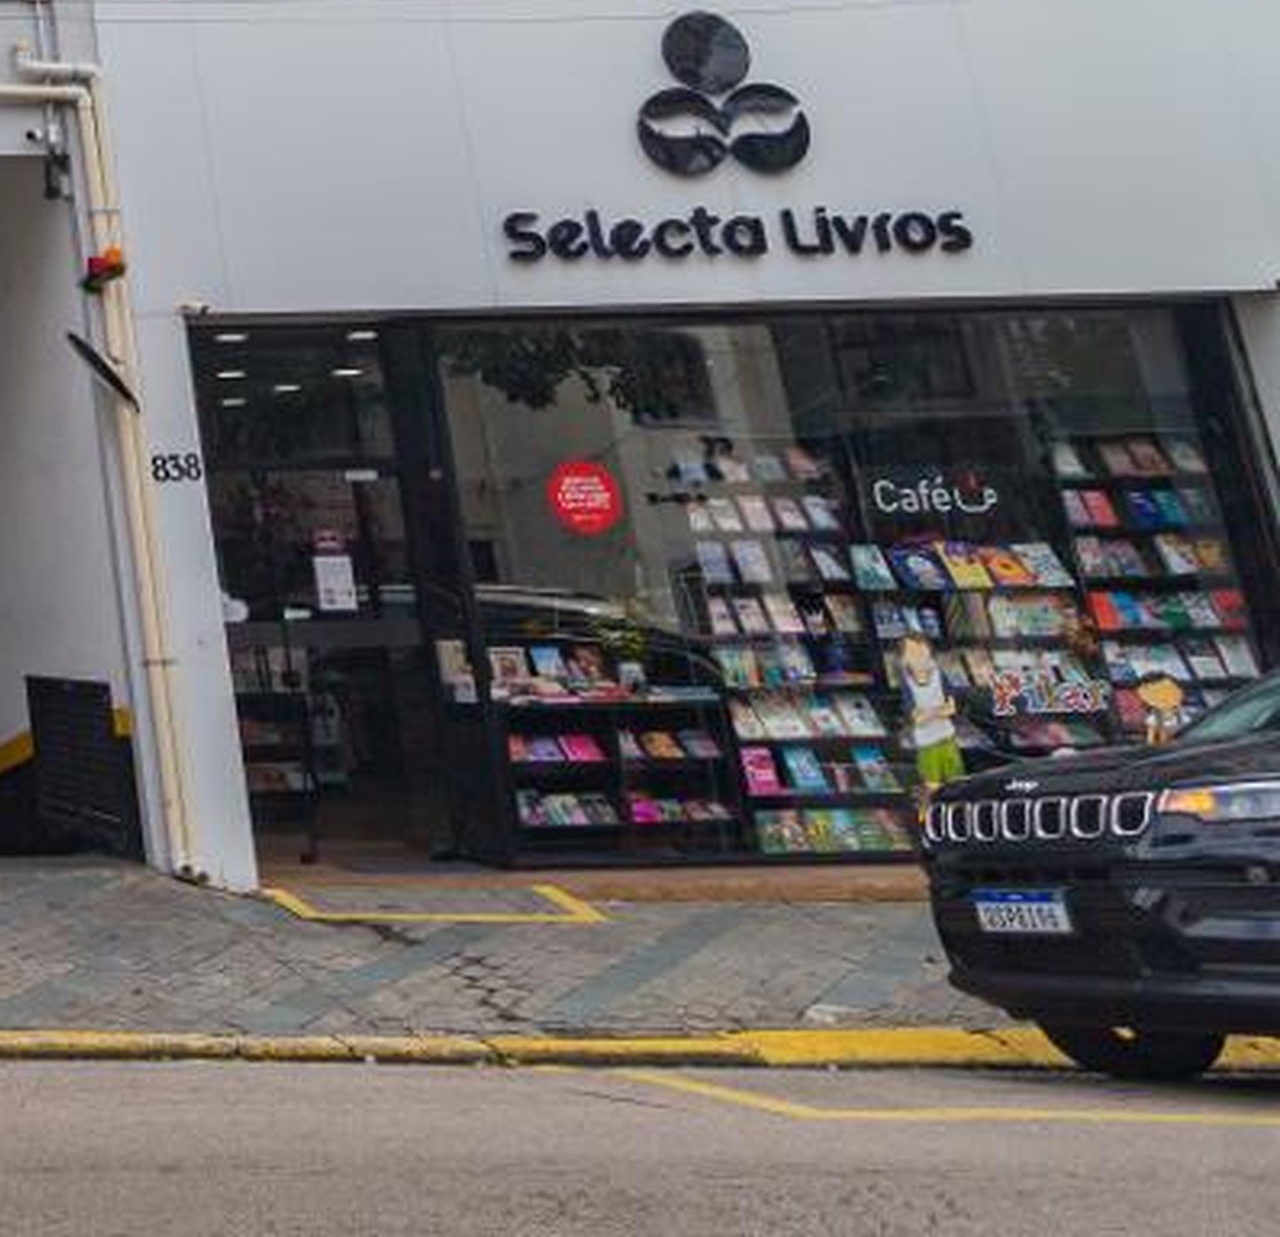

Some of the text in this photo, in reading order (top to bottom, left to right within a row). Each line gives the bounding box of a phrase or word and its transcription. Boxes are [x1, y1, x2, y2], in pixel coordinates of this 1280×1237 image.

[502, 206, 974, 264] Selecta Livros
[151, 453, 202, 481] 838
[873, 475, 952, 513] Café
